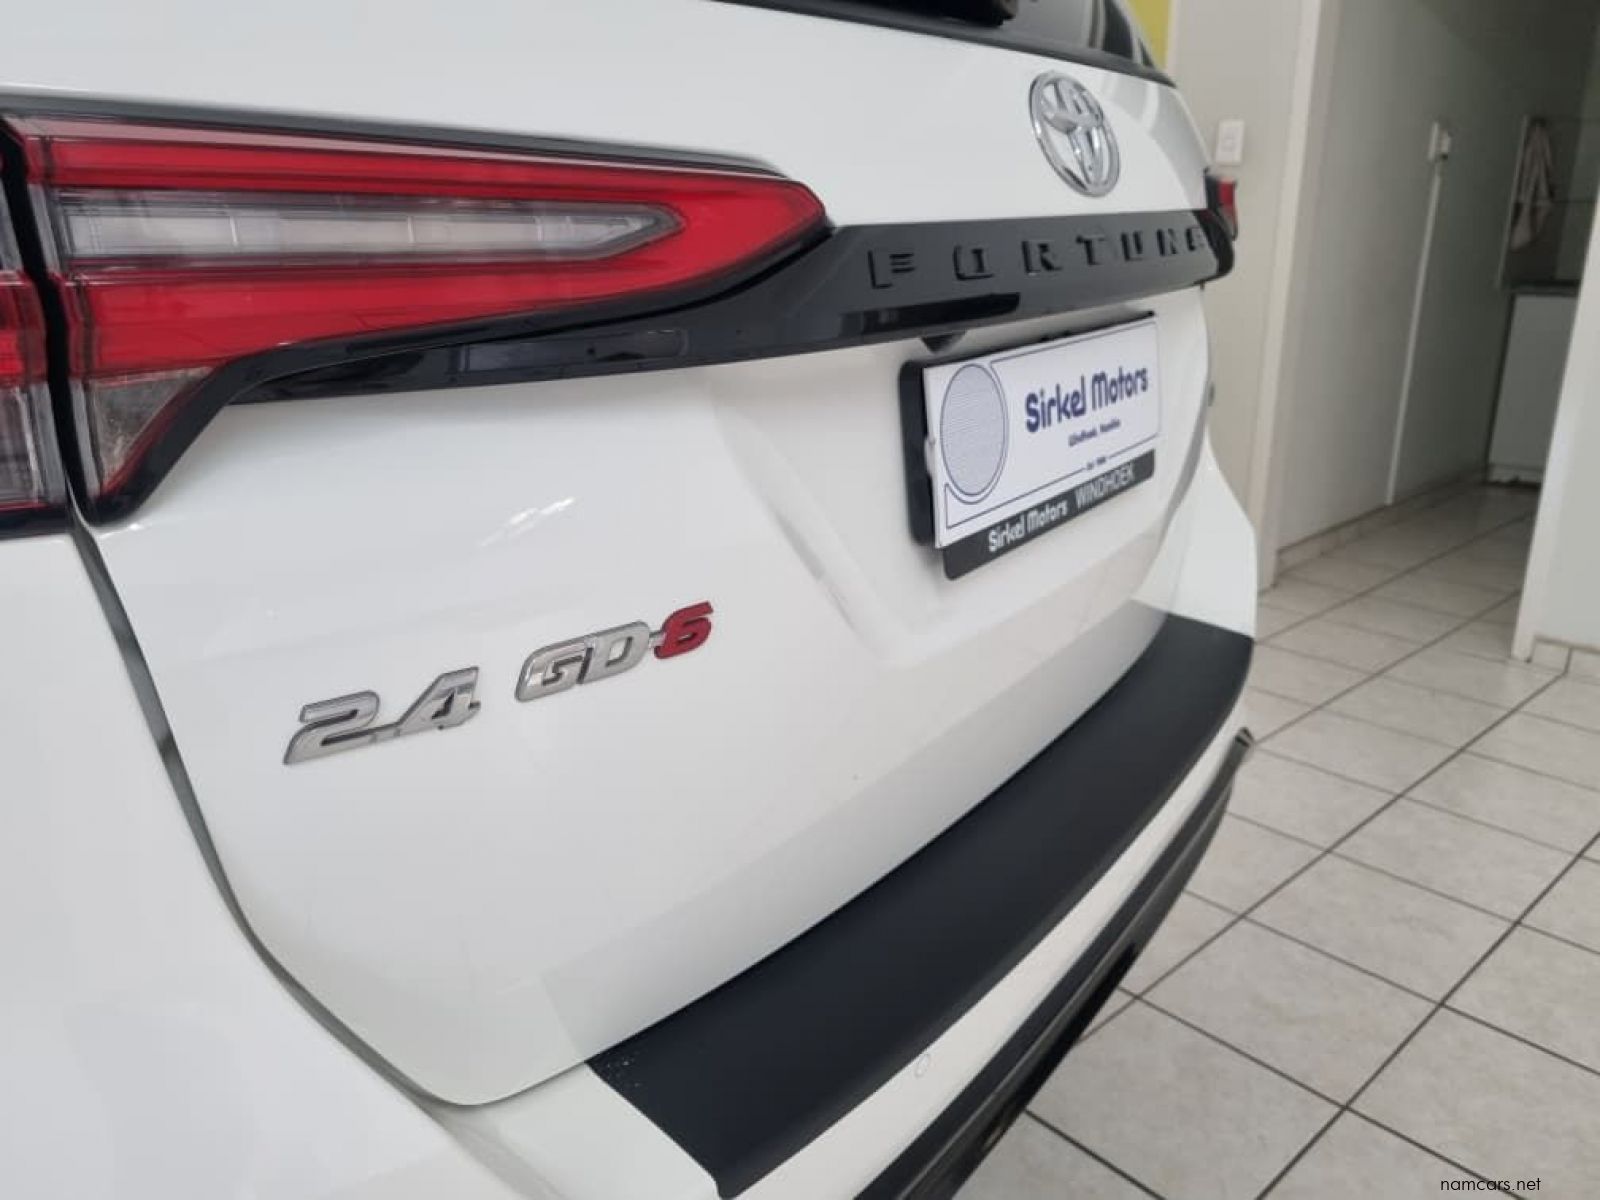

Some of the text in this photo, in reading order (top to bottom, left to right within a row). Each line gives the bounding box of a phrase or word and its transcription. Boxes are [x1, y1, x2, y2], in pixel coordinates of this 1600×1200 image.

[1025, 375, 1087, 433] Sirkel
[1092, 367, 1148, 411] Motors
[988, 464, 1135, 552] Sirkel Motors WINDHOEK
[283, 600, 713, 765] 2.4 GD-6
